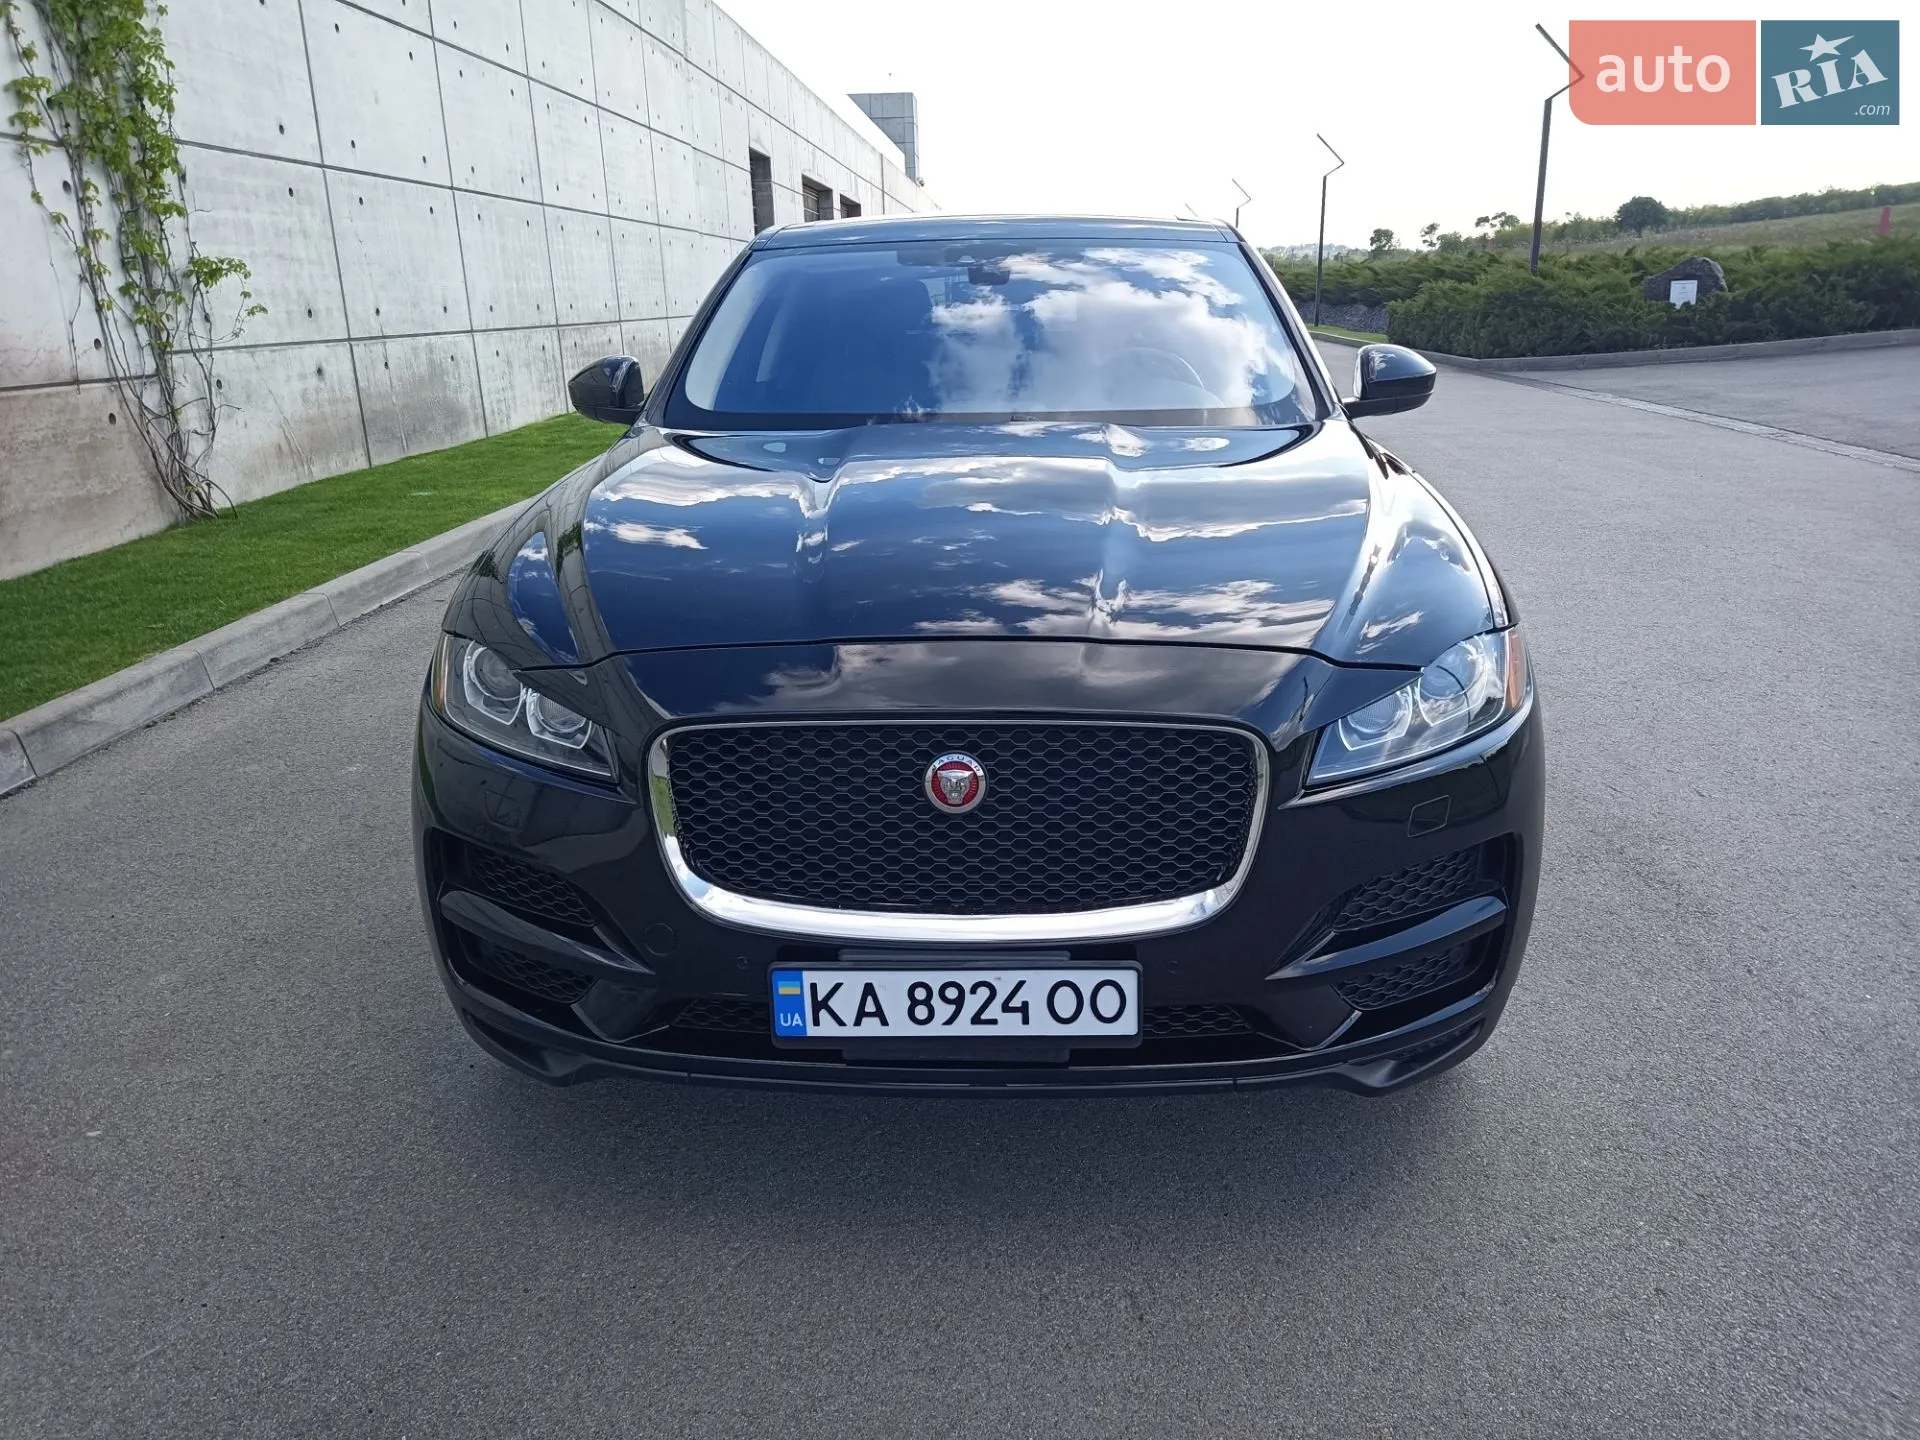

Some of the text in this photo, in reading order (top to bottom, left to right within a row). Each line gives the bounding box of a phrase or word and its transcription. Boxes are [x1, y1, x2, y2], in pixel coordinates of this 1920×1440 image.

[809, 979, 1127, 1028] KA 8924 OO
[779, 1012, 803, 1028] UA
